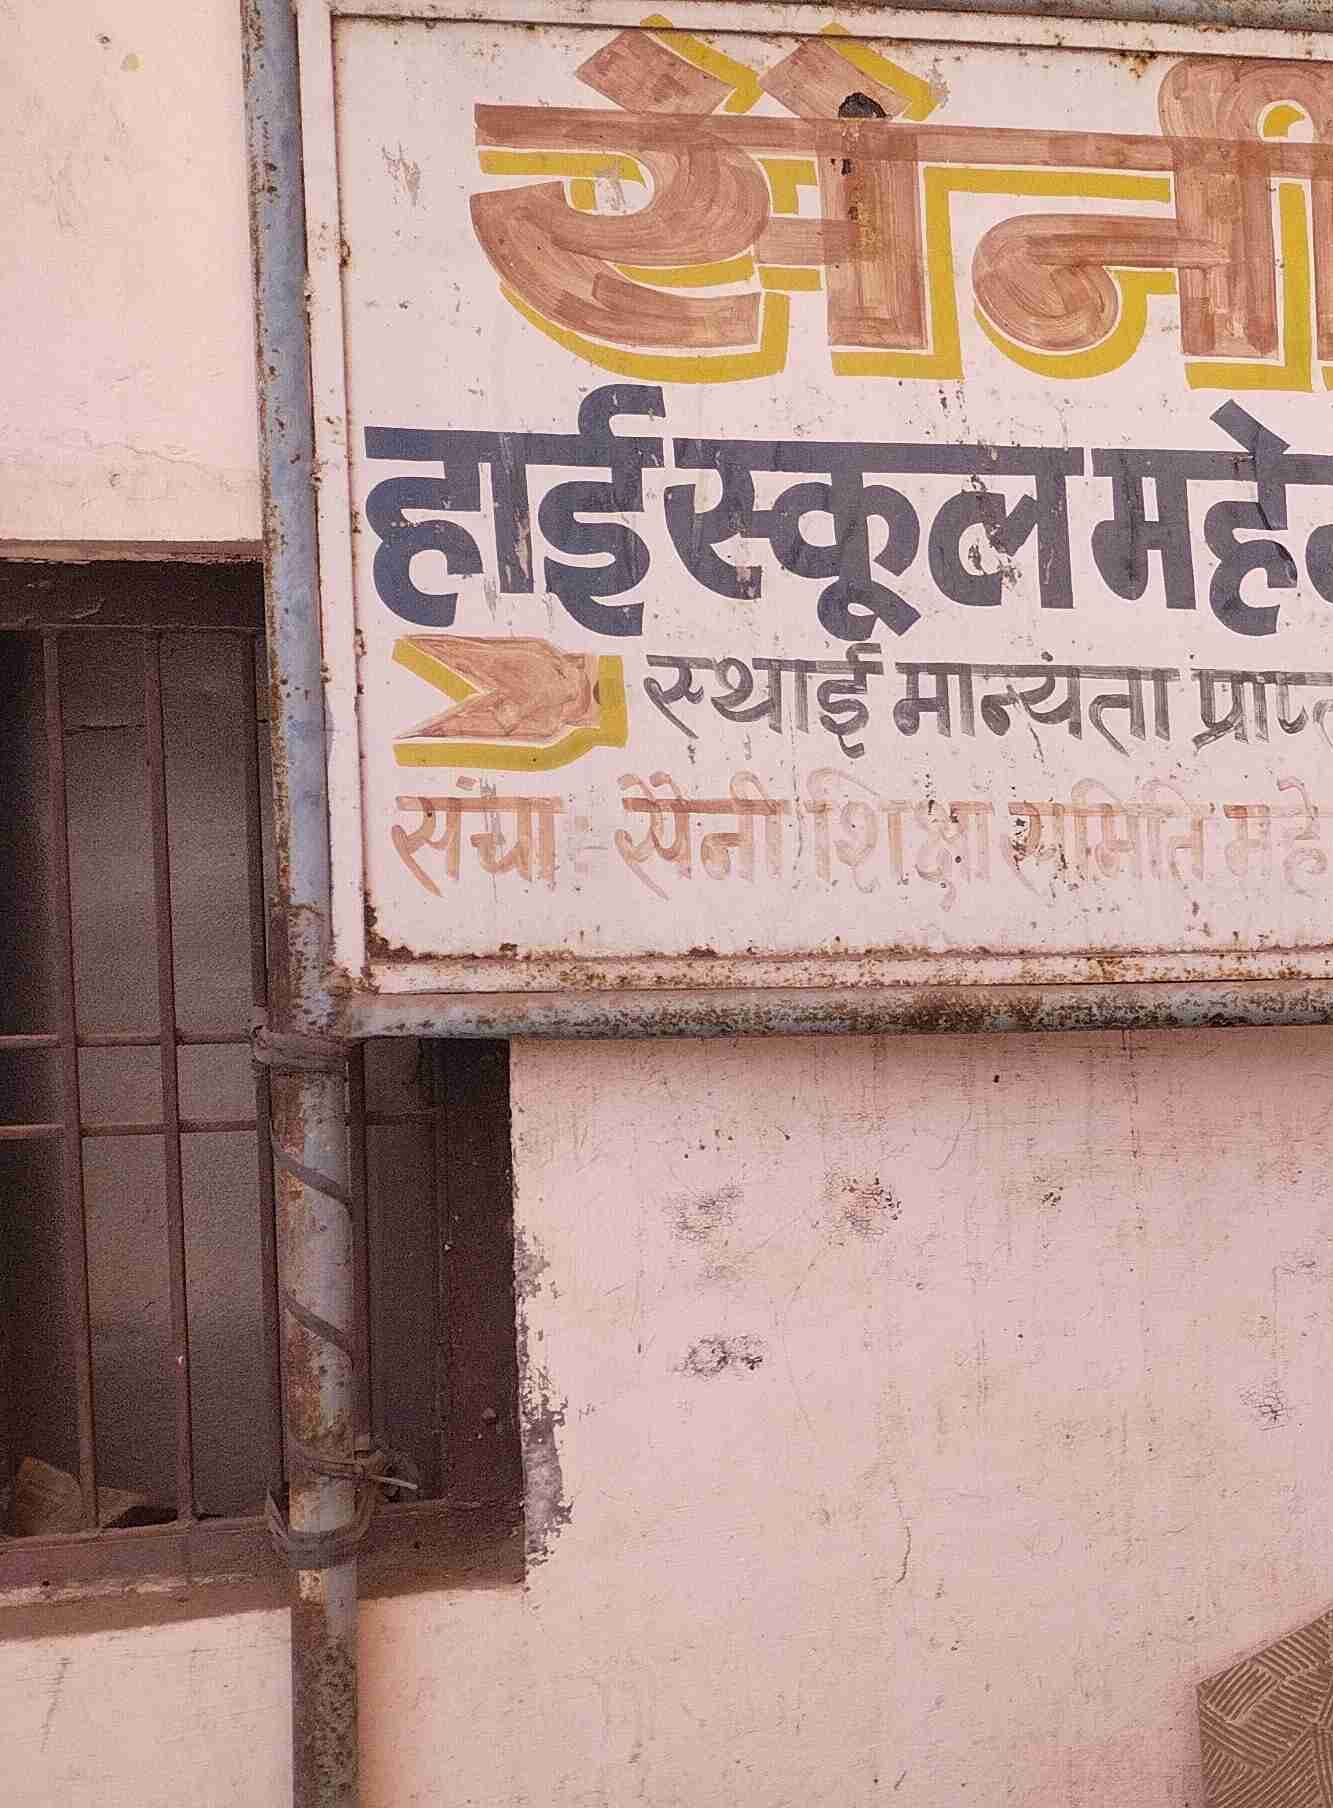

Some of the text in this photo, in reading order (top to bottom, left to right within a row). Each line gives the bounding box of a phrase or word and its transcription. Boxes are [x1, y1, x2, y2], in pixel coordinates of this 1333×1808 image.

[364, 384, 666, 637] हाई
[664, 437, 1085, 642] स्कूल
[643, 642, 883, 758] स्थाई
